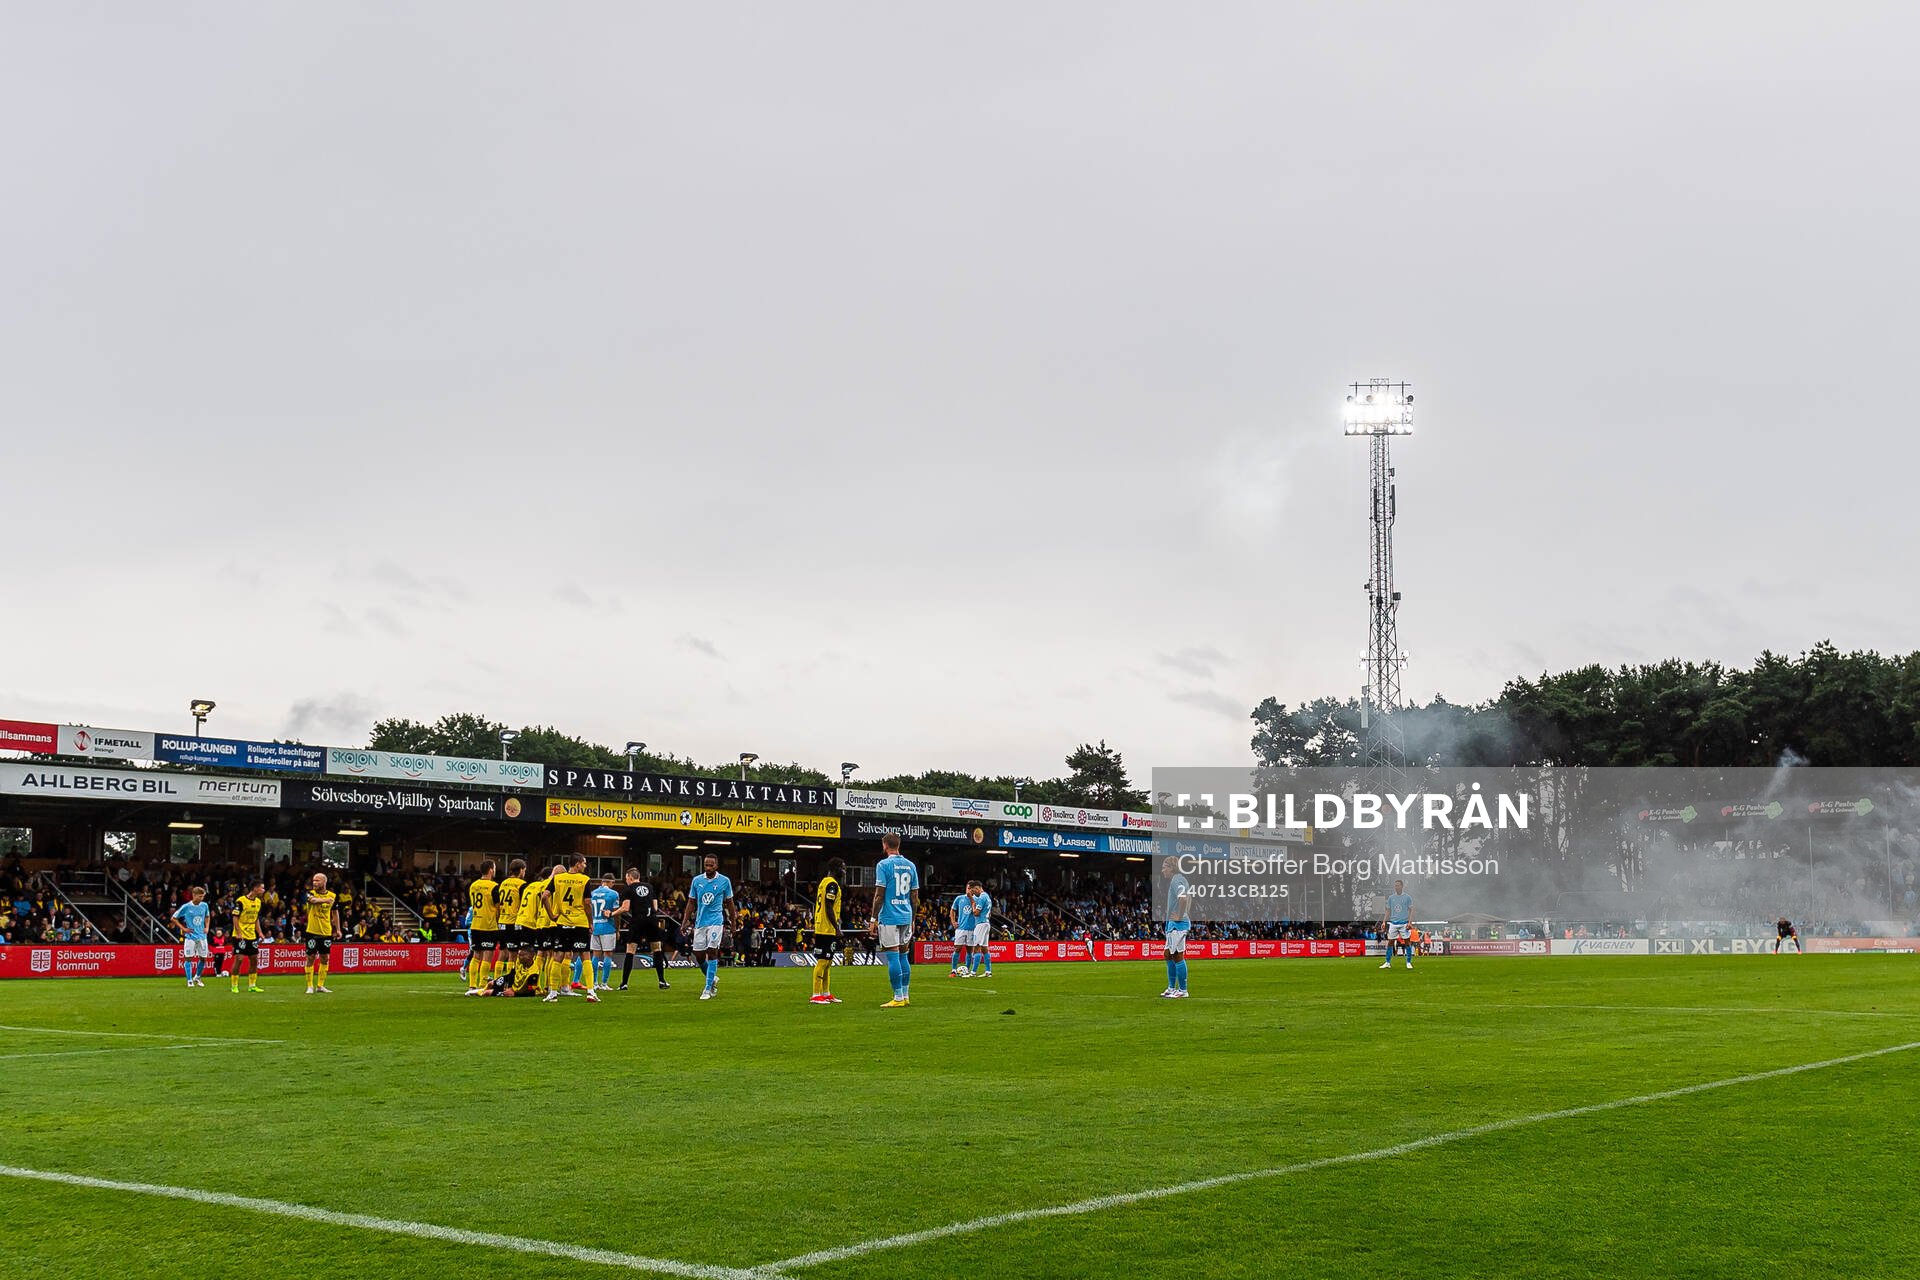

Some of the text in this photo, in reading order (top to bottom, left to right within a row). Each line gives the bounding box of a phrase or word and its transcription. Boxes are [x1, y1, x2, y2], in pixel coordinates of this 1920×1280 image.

[162, 739, 237, 755] ROLLUP-KUNGEN
[247, 744, 322, 758] Rolluper, Beachflaggor
[254, 756, 292, 766] Banderoller
[293, 759, 302, 768] på
[303, 760, 320, 768] nätet
[331, 751, 378, 768] SKOLON
[390, 756, 434, 772] SKOLON
[446, 760, 488, 775] SKOLON
[500, 764, 540, 779] SKOLON
[22, 773, 177, 794] AHLBERG BIL
[199, 780, 278, 794] meritum
[311, 787, 494, 812] Sölvesborg-Mjällby Sparbank
[845, 790, 888, 808] Lönneberga
[895, 795, 936, 811] Lönneberga
[562, 802, 677, 823] Sölvesborgs kommun
[1003, 804, 1033, 819] coop
[695, 811, 733, 828] Mjällby
[766, 817, 825, 832] hemmaplan
[857, 821, 968, 840] Sölvesborg-Mjällby Sparbank
[1013, 835, 1049, 844] LARSSON
[1062, 838, 1096, 847] LARSSON
[1108, 835, 1160, 854] NORRVIDINGE
[894, 872, 911, 897] 18
[471, 891, 483, 909] 18
[499, 889, 513, 906] 24
[521, 891, 532, 908] 5
[563, 886, 574, 906] 4
[592, 898, 606, 917] 17
[362, 948, 410, 959] Sölvesborgs
[1572, 940, 1635, 954] K-VAGNEN
[56, 950, 116, 962] Sölvesborgs
[274, 959, 306, 968] kommu
[362, 958, 397, 967] kommun
[56, 962, 100, 971] kommun
